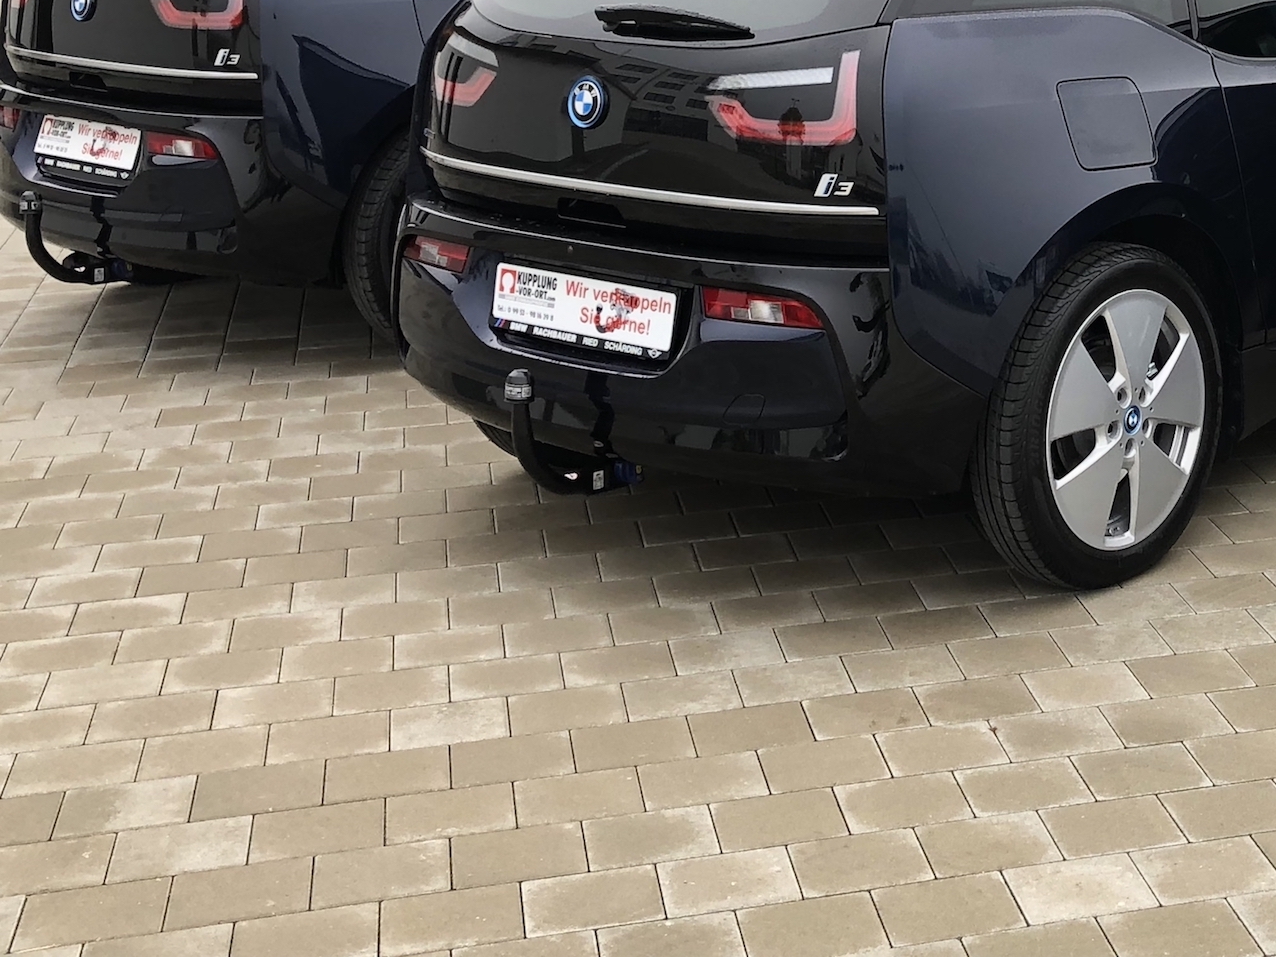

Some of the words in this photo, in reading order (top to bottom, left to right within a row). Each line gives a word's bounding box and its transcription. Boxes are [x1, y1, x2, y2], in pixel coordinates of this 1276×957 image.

[77, 123, 91, 135] Wir
[516, 271, 558, 291] KUPPLUNG
[565, 279, 590, 299] Wir
